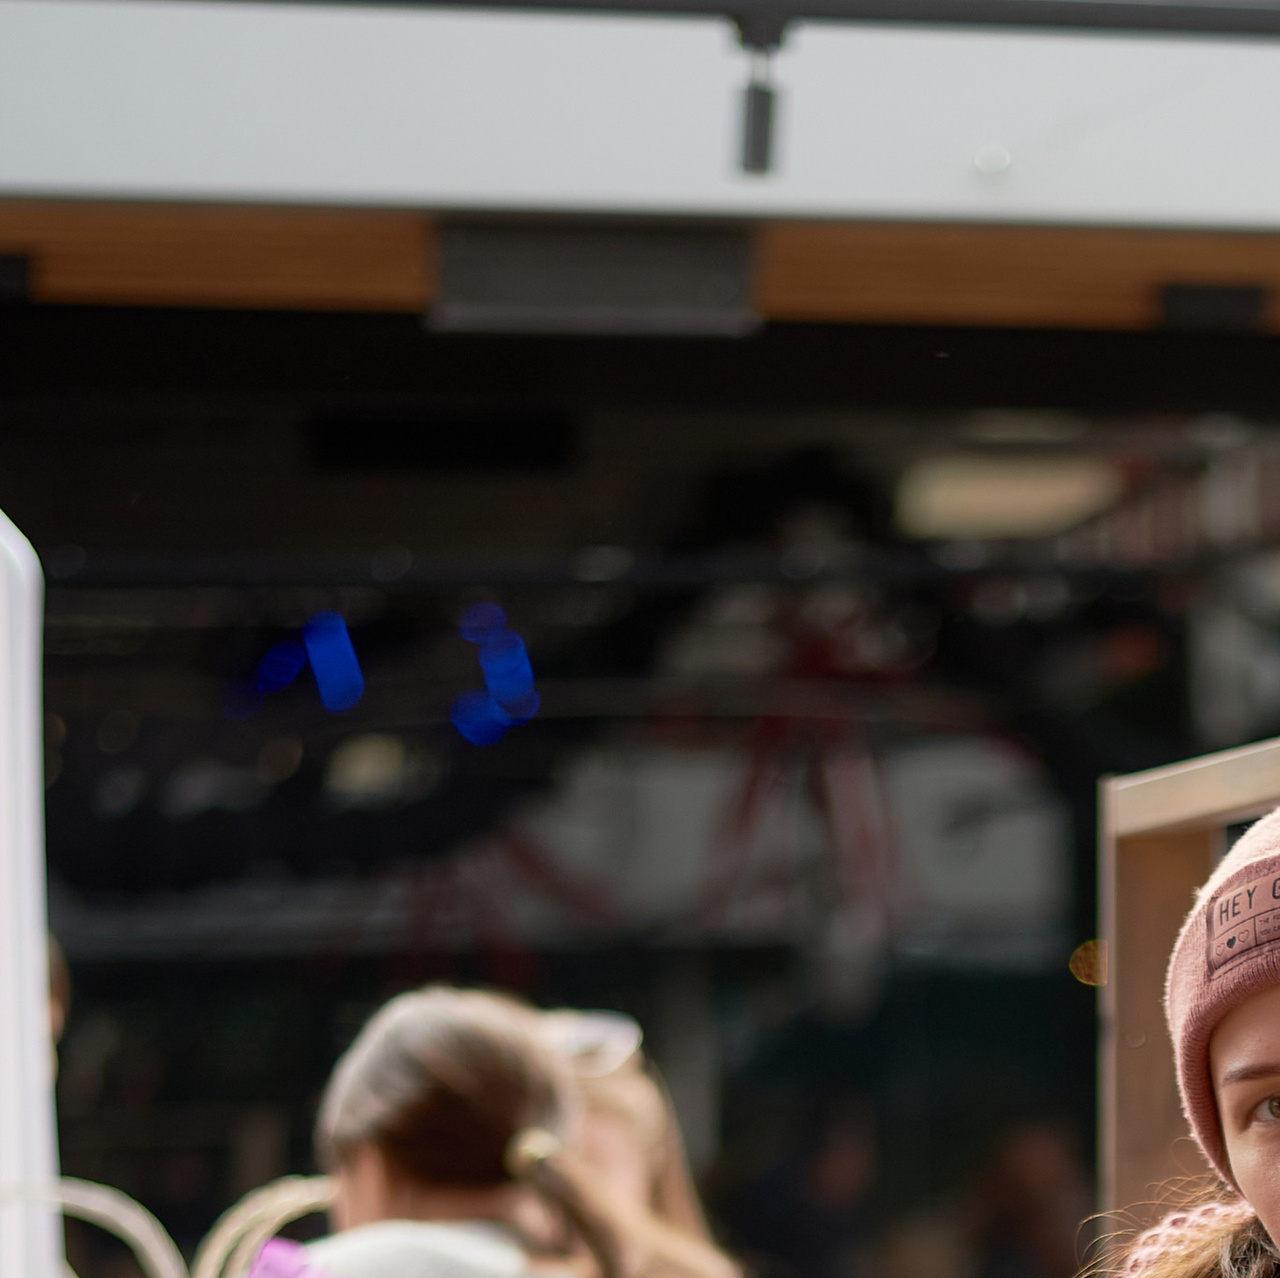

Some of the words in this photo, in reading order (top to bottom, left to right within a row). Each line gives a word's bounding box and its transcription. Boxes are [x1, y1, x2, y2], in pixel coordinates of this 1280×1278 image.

[1219, 884, 1257, 926] HEY
[1259, 917, 1270, 925] THE
[1259, 927, 1272, 936] YOU
